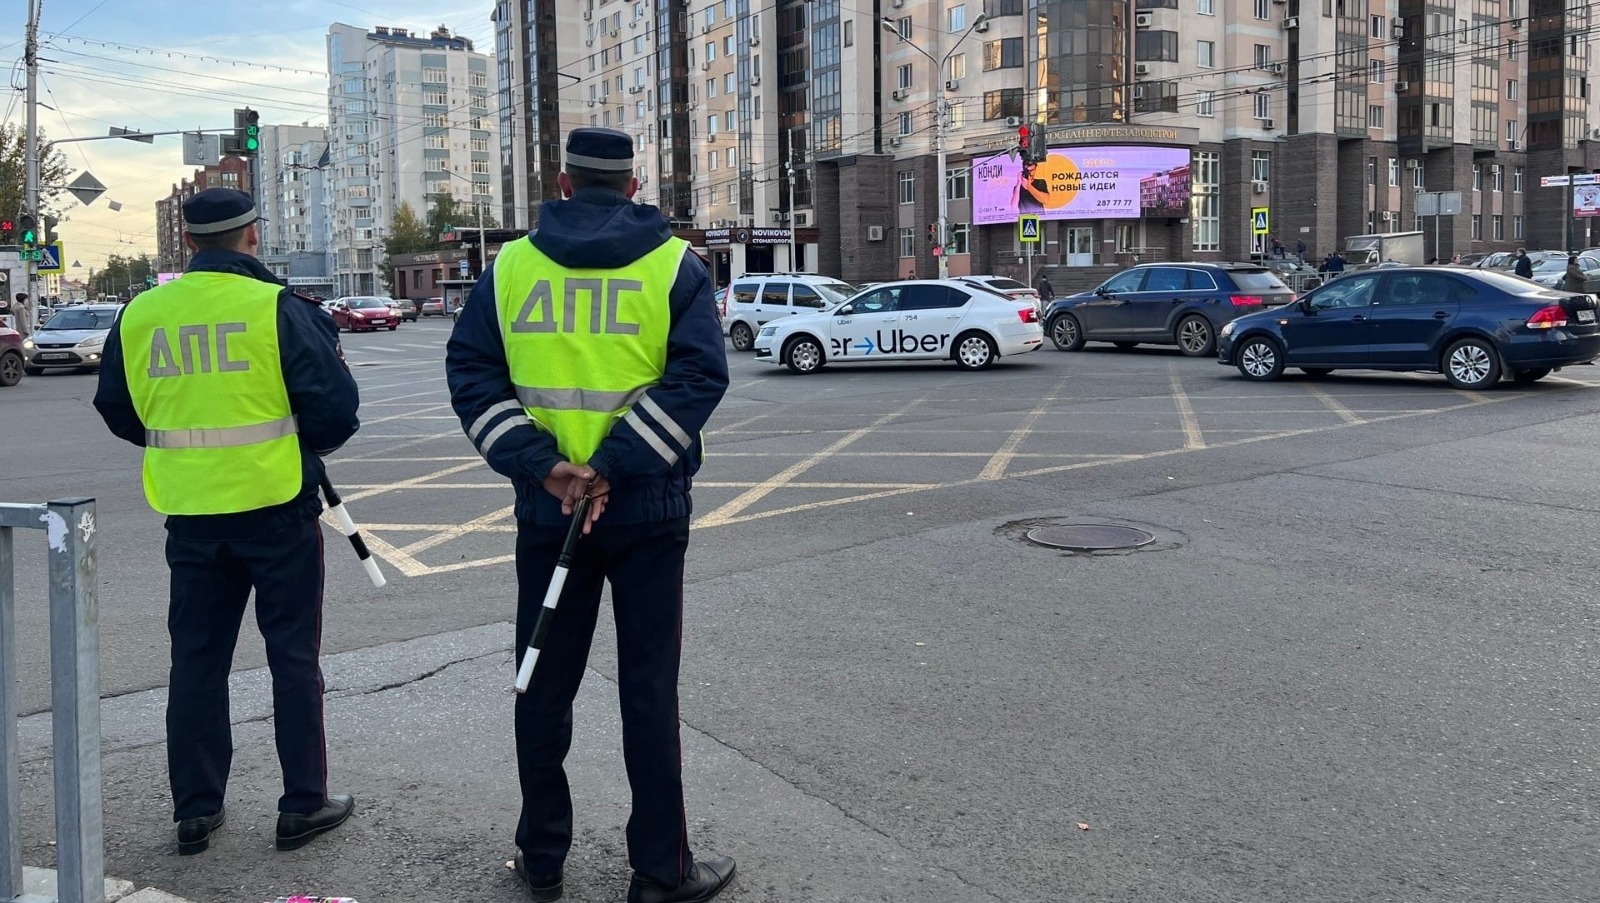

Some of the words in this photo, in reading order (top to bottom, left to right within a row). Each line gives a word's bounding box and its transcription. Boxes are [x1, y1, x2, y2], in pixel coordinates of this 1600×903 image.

[1051, 171, 1119, 181] РОЖДАЮТСЯ
[1051, 184, 1087, 192] НОВЫЕ
[1089, 182, 1116, 191] ИДЕИ
[1096, 199, 1110, 207] 287
[510, 277, 643, 335] ДПС
[147, 322, 250, 378] ДПС
[877, 329, 950, 354] Uber
